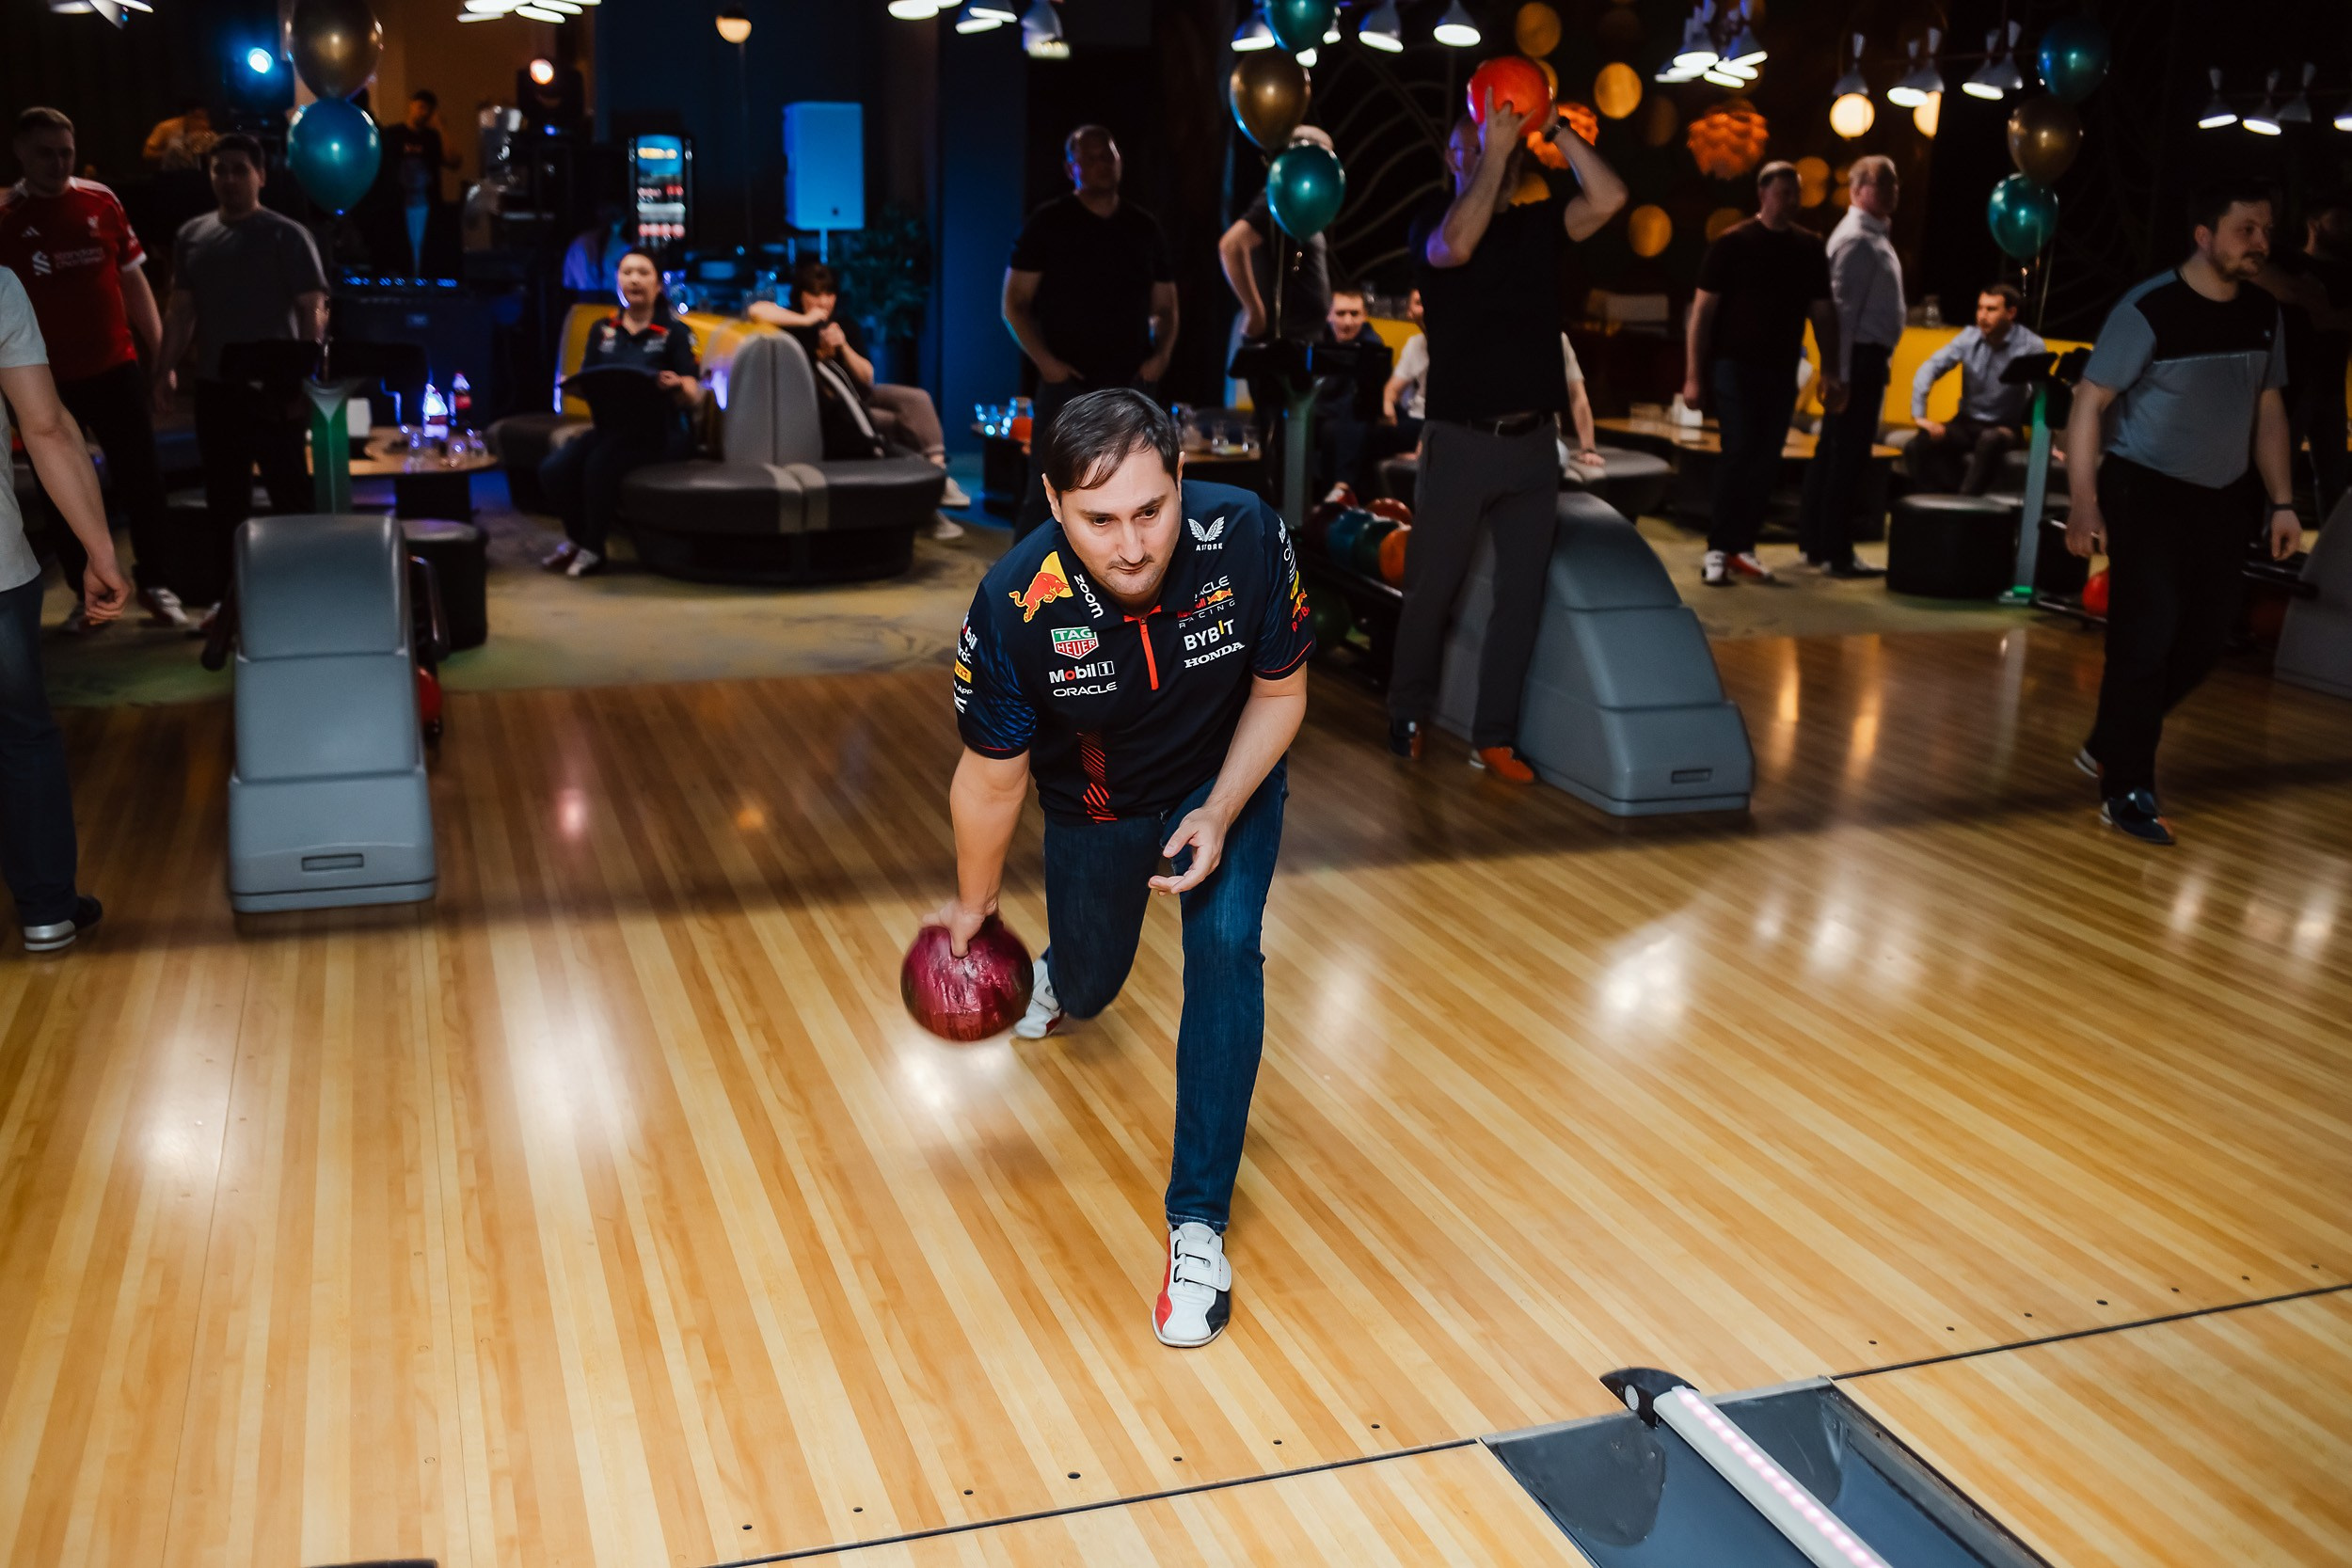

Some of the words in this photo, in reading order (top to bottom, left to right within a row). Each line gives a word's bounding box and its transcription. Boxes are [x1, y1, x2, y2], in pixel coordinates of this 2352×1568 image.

[1073, 574, 1104, 619] zoom
[1056, 628, 1094, 641] TAG
[1184, 619, 1234, 651] BYBIT
[1057, 640, 1096, 656] HEUER
[1184, 641, 1245, 668] HONDA
[1049, 663, 1097, 683] Mobil
[1053, 682, 1118, 697] ORACLE
